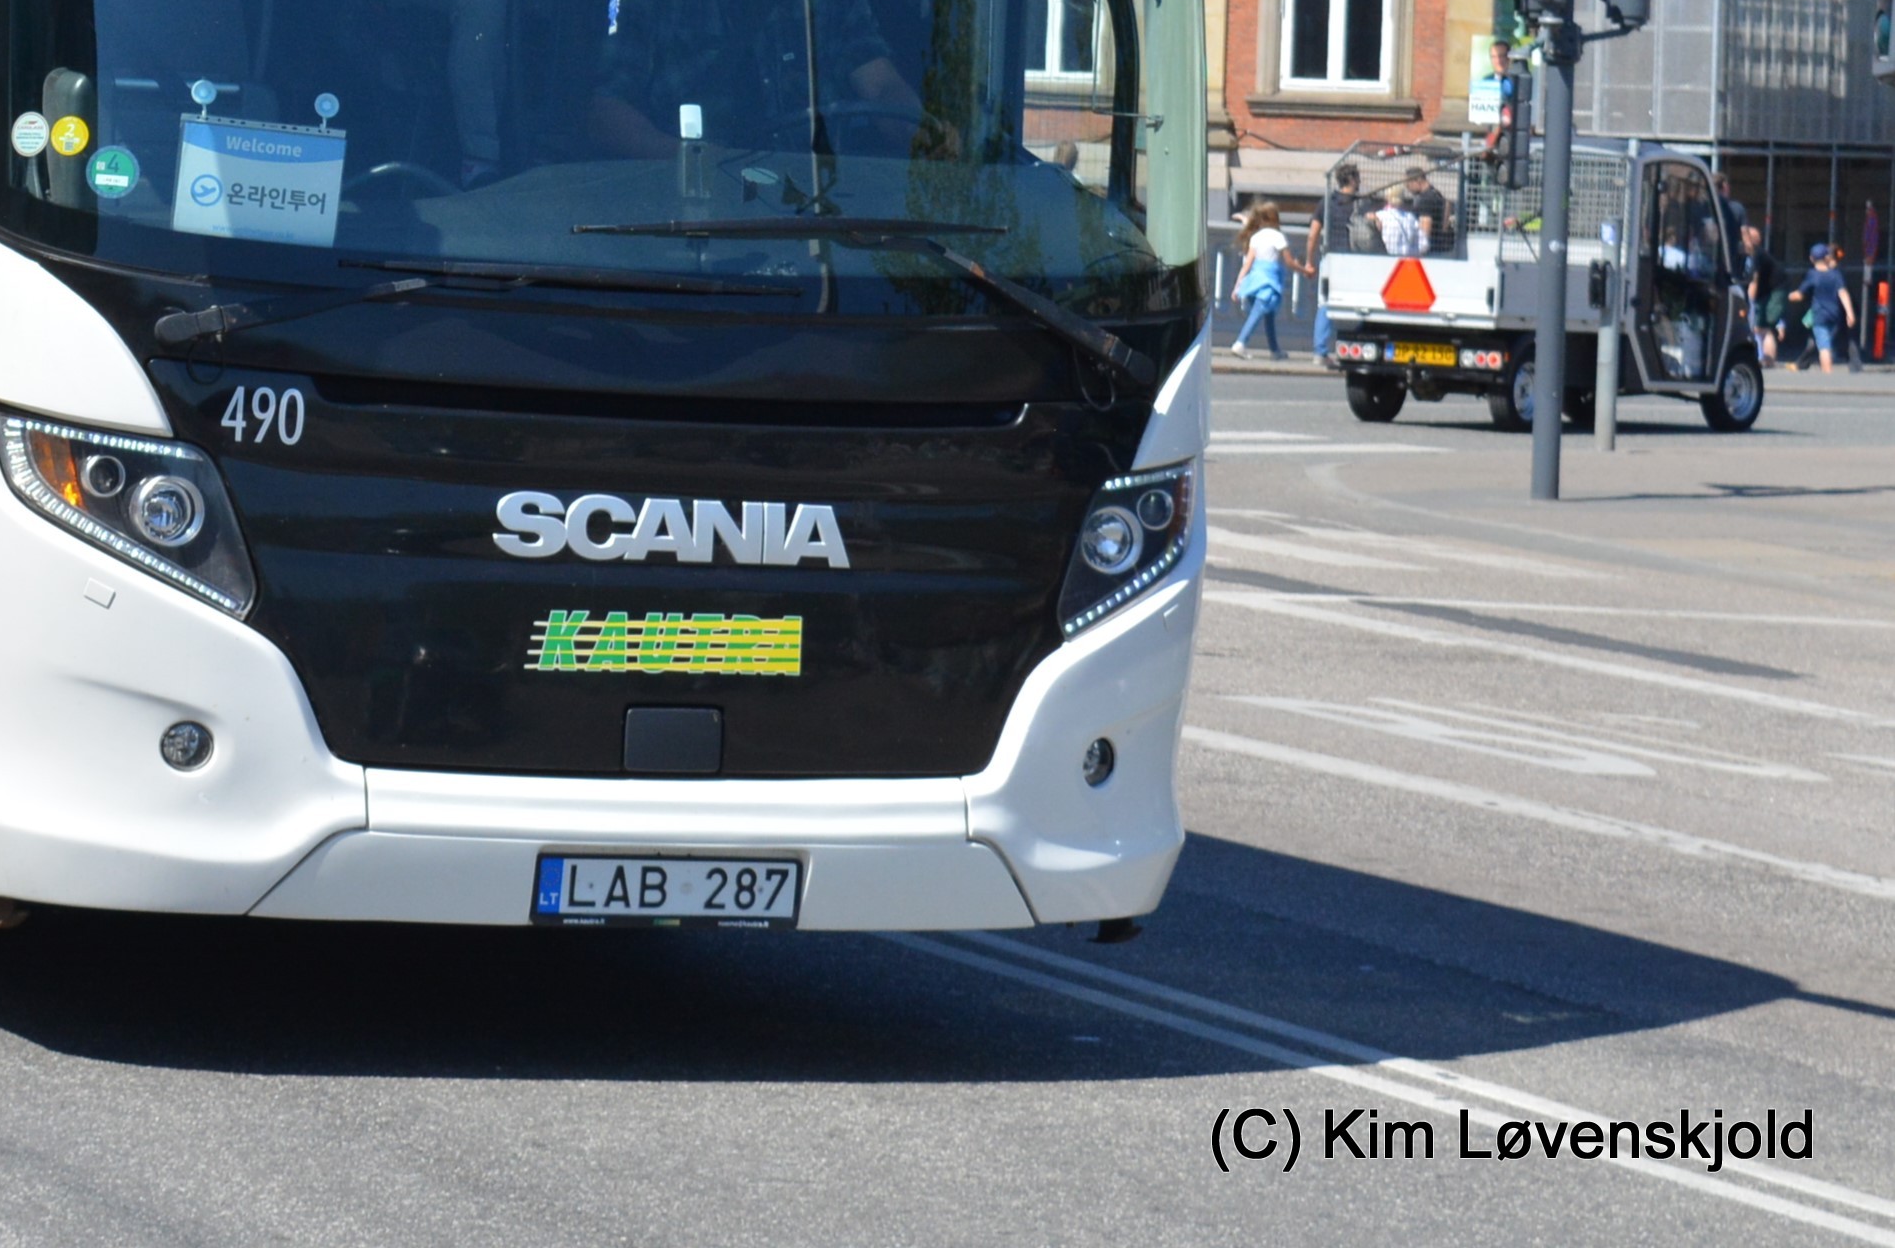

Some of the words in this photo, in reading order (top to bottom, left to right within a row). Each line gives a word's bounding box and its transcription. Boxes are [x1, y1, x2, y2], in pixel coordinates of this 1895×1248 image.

[106, 153, 120, 173] 4
[226, 135, 303, 158] Welcome
[227, 182, 327, 215] 온라인투어
[220, 385, 305, 446] 490
[492, 491, 851, 569] SCANIA
[535, 609, 803, 677] KAUTRA
[539, 892, 559, 905] LT
[567, 864, 668, 909] LAB
[703, 867, 790, 911] 287
